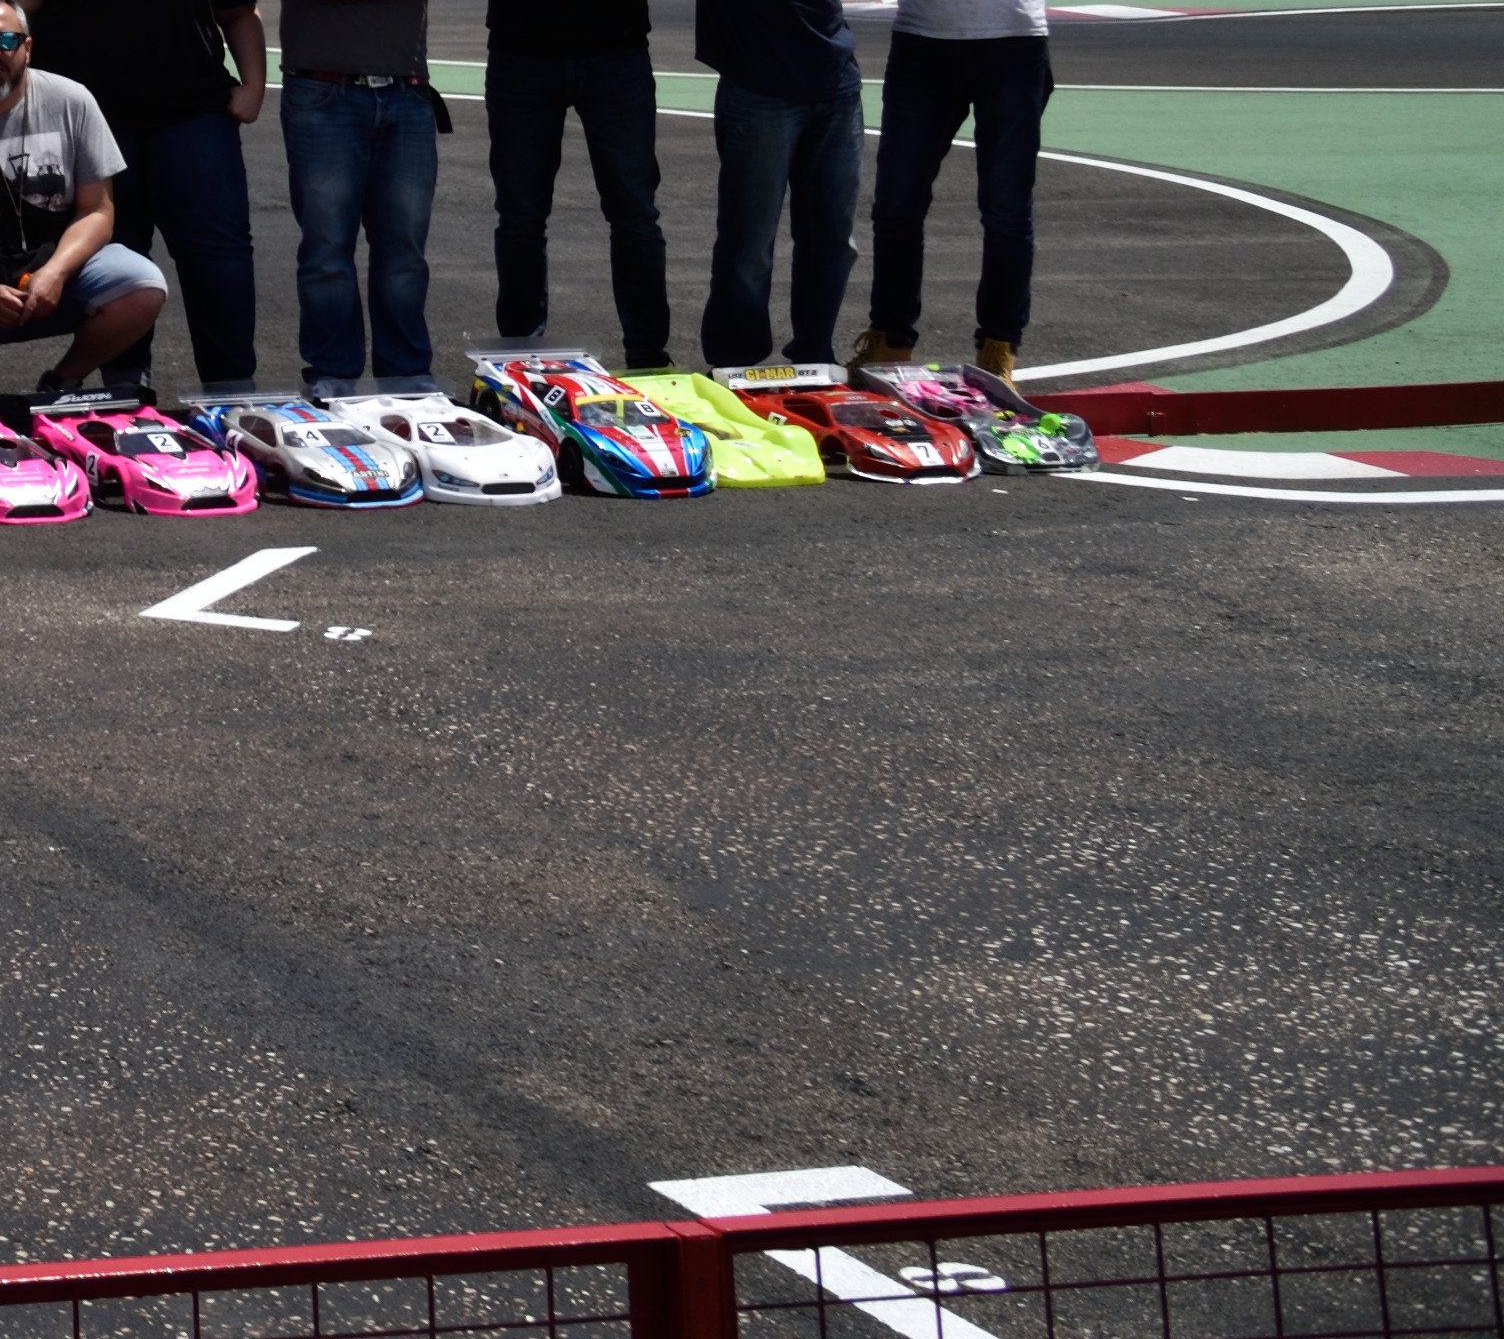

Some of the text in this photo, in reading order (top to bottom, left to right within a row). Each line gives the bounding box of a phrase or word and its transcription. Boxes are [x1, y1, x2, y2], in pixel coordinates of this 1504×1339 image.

[305, 429, 320, 441] 4
[426, 425, 444, 436] 2
[154, 436, 173, 448] 2
[917, 445, 930, 458] 7
[88, 454, 96, 476] 2
